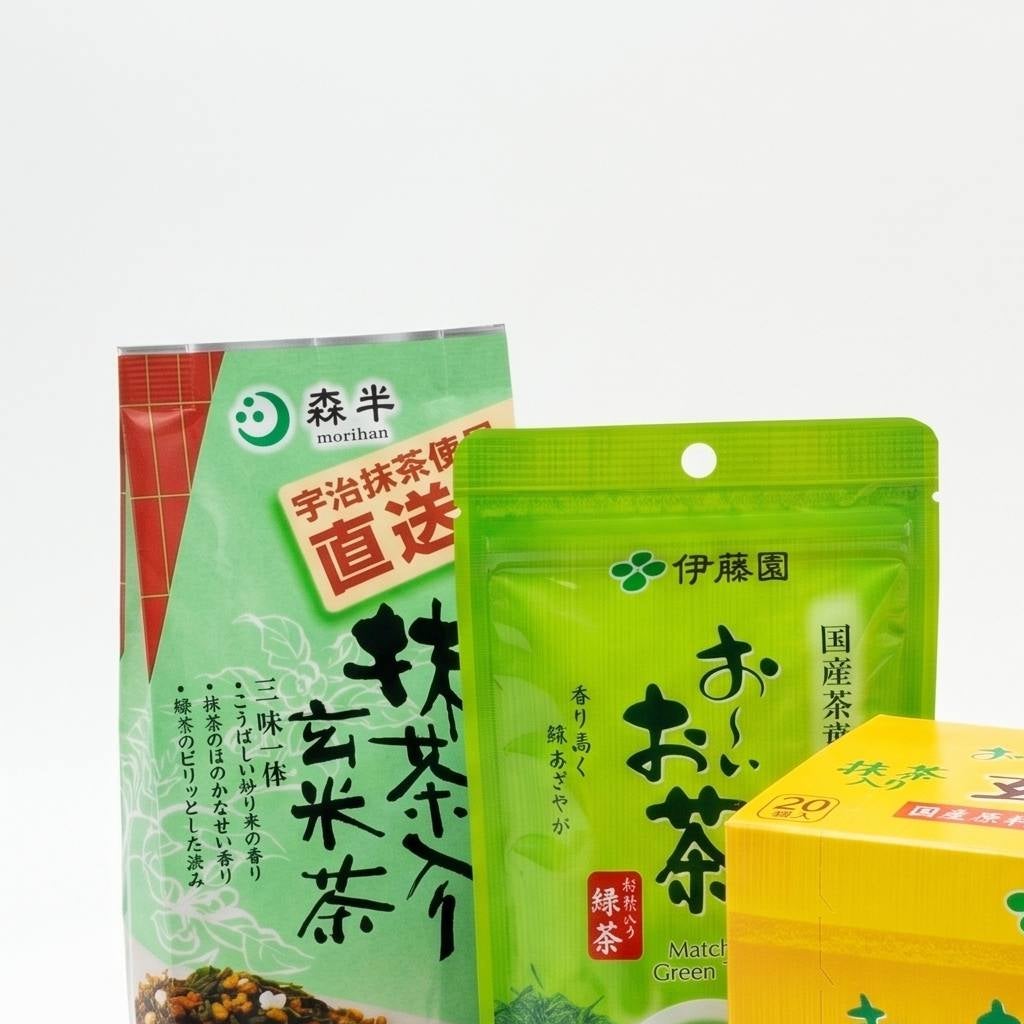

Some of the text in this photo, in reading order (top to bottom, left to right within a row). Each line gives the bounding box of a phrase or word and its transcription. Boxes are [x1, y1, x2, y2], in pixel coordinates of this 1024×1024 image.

[307, 384, 395, 427] 森半
[317, 427, 389, 444] morihan
[309, 482, 456, 596] 直送
[672, 551, 789, 585] 伊藤園
[255, 677, 287, 788] 三味一体
[289, 699, 396, 944] 玄米茶
[622, 683, 748, 915] お茶
[774, 796, 831, 812] 20
[591, 887, 624, 956] 緑茶
[653, 963, 715, 982] Green
